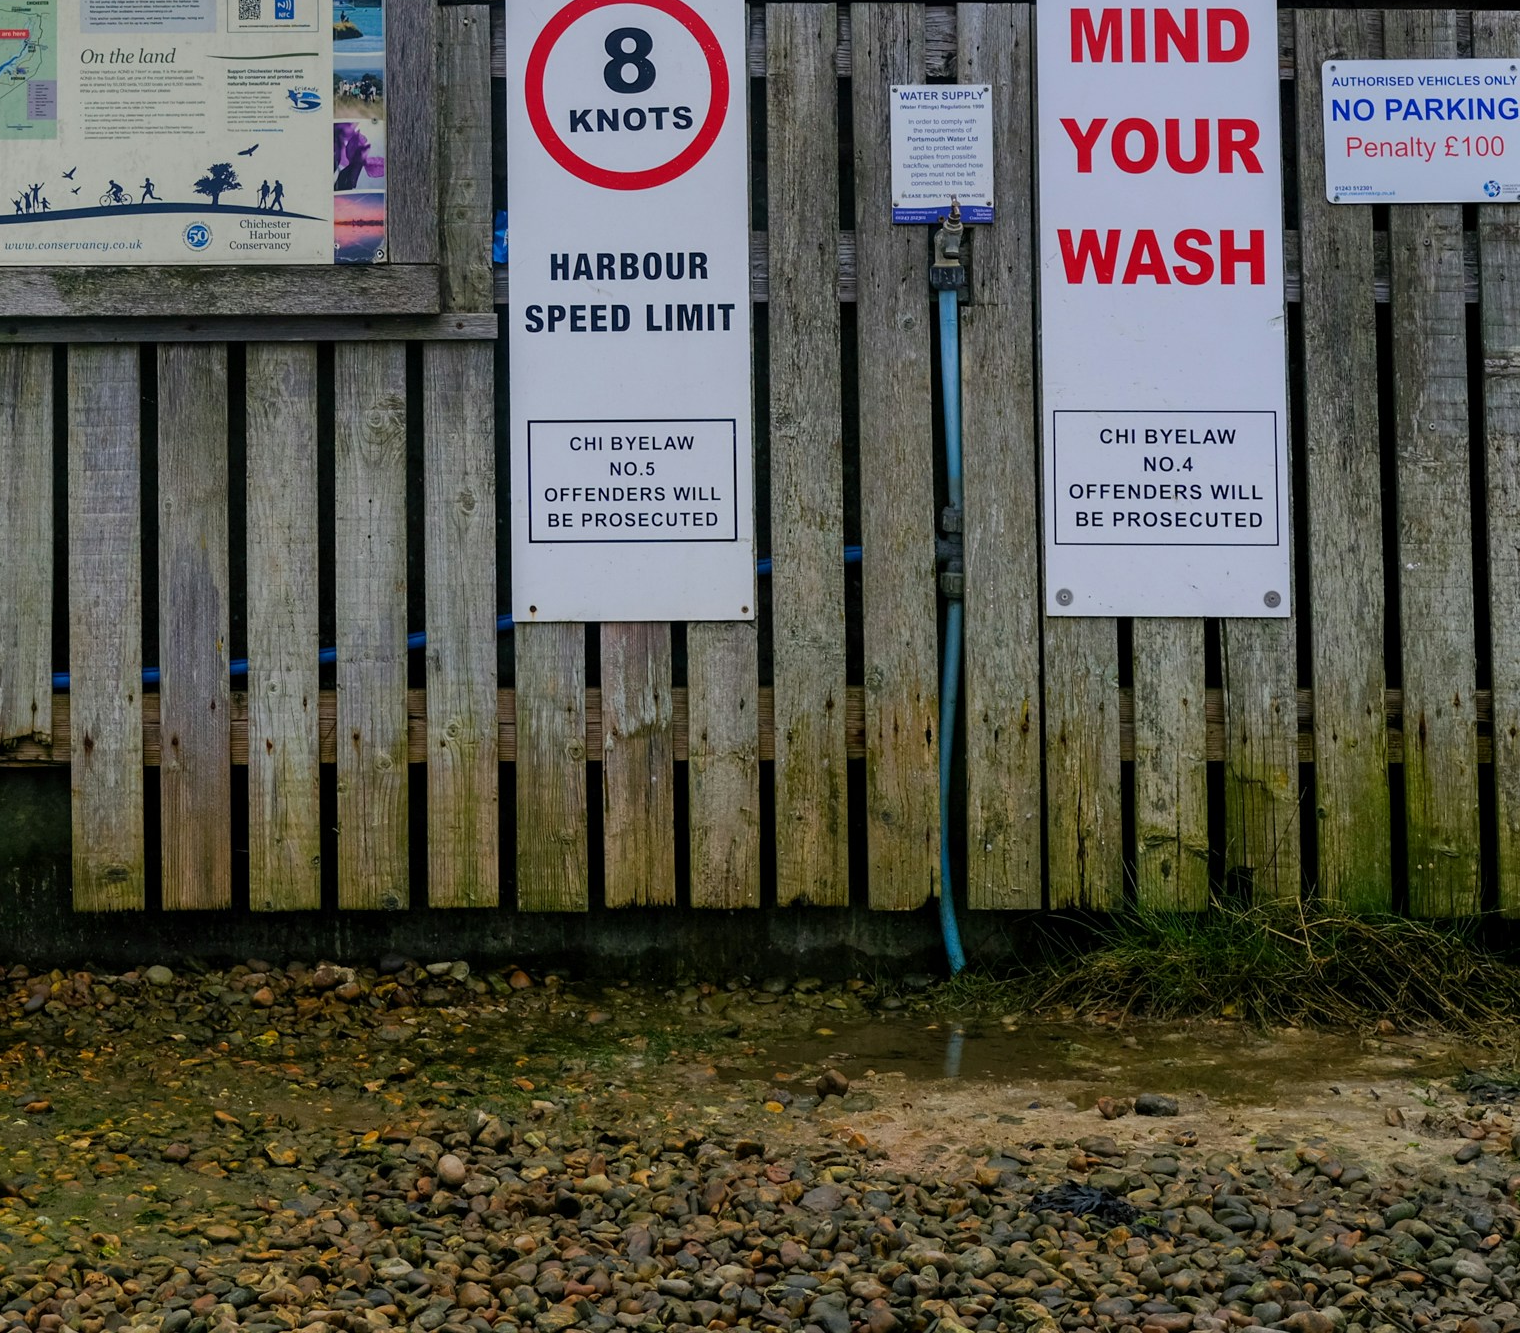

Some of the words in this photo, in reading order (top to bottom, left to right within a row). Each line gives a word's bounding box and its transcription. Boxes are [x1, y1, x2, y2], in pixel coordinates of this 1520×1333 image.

[1070, 8, 1250, 63] MIND
[80, 49, 104, 64] On
[109, 48, 134, 64] the
[138, 47, 176, 63] land
[603, 27, 656, 94] 8
[1332, 77, 1414, 87] AUTHORISED
[1418, 76, 1480, 86] VEHICLES
[1484, 75, 1517, 85] ONLY
[900, 91, 938, 100] WATER
[942, 91, 984, 100] SUPPLY
[1332, 99, 1374, 121] NO
[1385, 97, 1519, 121] PARKING
[570, 106, 693, 133] KNOTS
[1059, 117, 1264, 174] YOUR
[1346, 136, 1436, 163] Penalty
[1444, 135, 1504, 157] £100
[240, 219, 291, 229] Chichester
[188, 229, 209, 243] 50
[250, 230, 291, 239] Harbour
[4, 239, 143, 252] www.conservancy.co.uk
[229, 241, 291, 251] Conservancy
[1057, 229, 1266, 286] WASH
[550, 252, 708, 281] HARBOUR
[525, 304, 630, 333] SPEED
[646, 303, 735, 331] LIMIT
[570, 437, 602, 451] CHI
[611, 436, 694, 451] BYELAW
[1100, 429, 1135, 444] CHI
[1145, 429, 1236, 445] BYELAW
[610, 461, 655, 476] NO.5
[1144, 456, 1193, 472] NO.4
[544, 487, 666, 502] OFFENDERS
[673, 487, 721, 501] WILL
[1069, 483, 1202, 500] OFFENDERS
[1210, 485, 1263, 500] WILL
[548, 513, 573, 527] BE
[582, 512, 718, 527] PROSECUTED
[1076, 511, 1104, 527] BE
[1113, 511, 1262, 528] PROSECUTED
